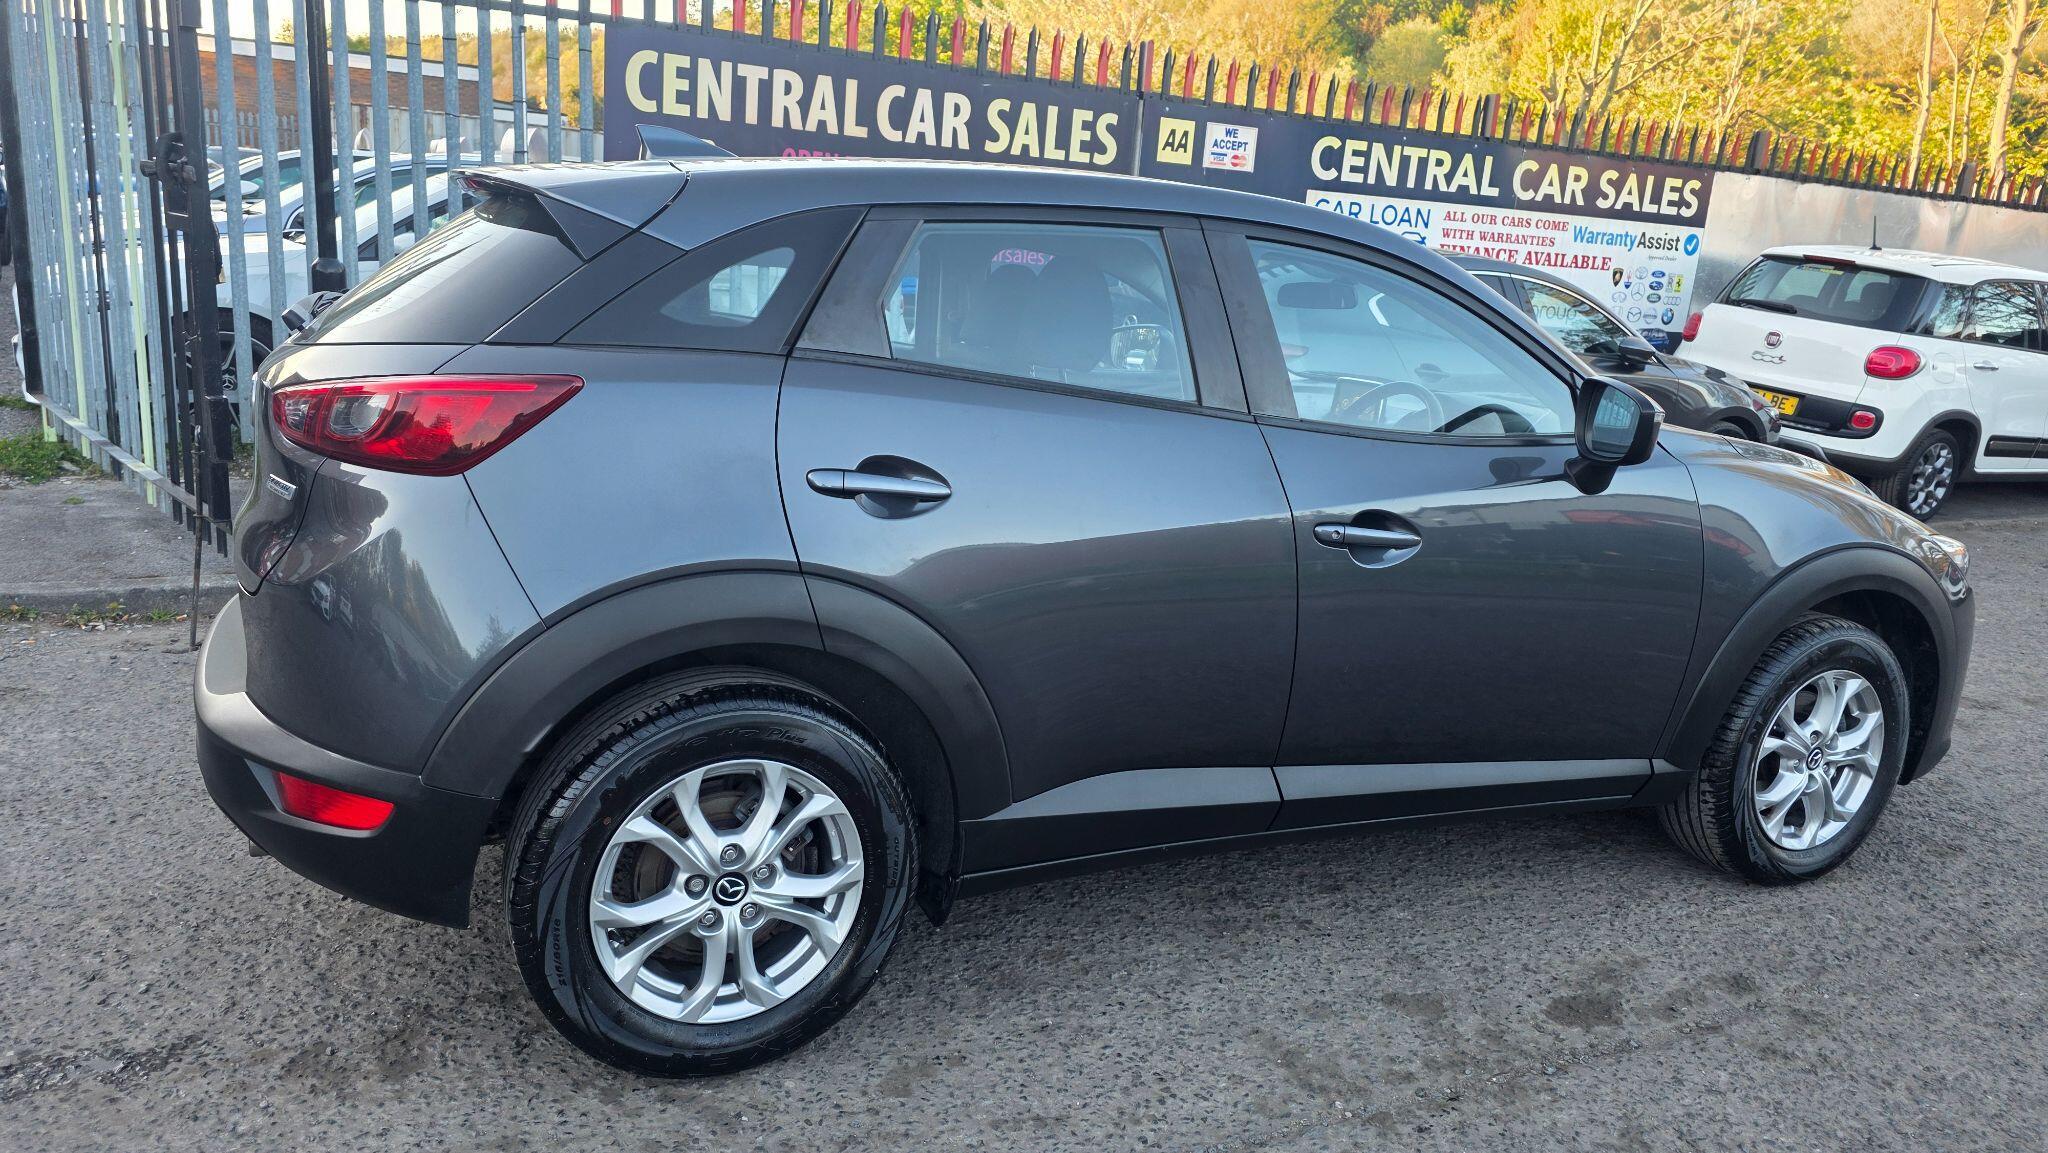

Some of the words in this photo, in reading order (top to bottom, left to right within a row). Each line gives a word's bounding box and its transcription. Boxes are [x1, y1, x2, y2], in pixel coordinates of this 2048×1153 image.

[624, 49, 869, 139] CENTRAL
[876, 84, 972, 151] CAR
[985, 98, 1118, 166] SALES
[1161, 128, 1189, 153] AA
[1225, 127, 1240, 138] WE
[1212, 139, 1249, 152] ACCEPT
[1310, 135, 1500, 198] CENTRAL
[1513, 159, 1589, 207] CAR
[1596, 168, 1702, 219] SALES
[1369, 203, 1431, 229] LOAN
[1443, 210, 1467, 222] ALL
[1471, 212, 1498, 226] OUR
[1501, 215, 1532, 229] CARS
[1535, 218, 1569, 232] COME
[1441, 227, 1475, 241] WITH
[1479, 230, 1556, 248] WARRANTIES
[1522, 250, 1612, 271] AVAILABLE
